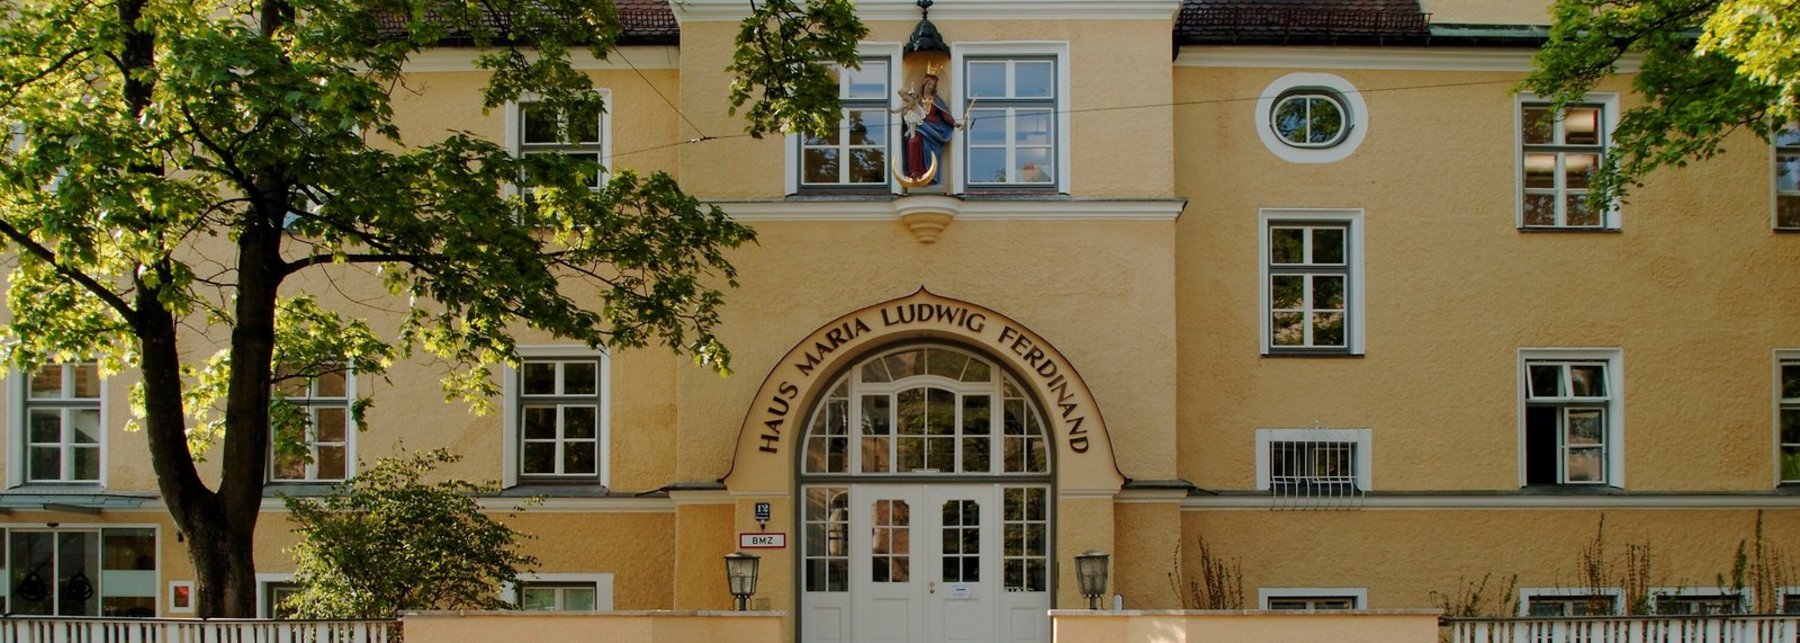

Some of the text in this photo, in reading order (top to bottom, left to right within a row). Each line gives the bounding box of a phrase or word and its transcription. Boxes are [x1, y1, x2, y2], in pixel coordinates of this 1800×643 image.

[758, 303, 1090, 454] HAUS MARIA LUDWIG FERDINAND
[757, 504, 769, 512] 12
[752, 536, 773, 545] BMZ
